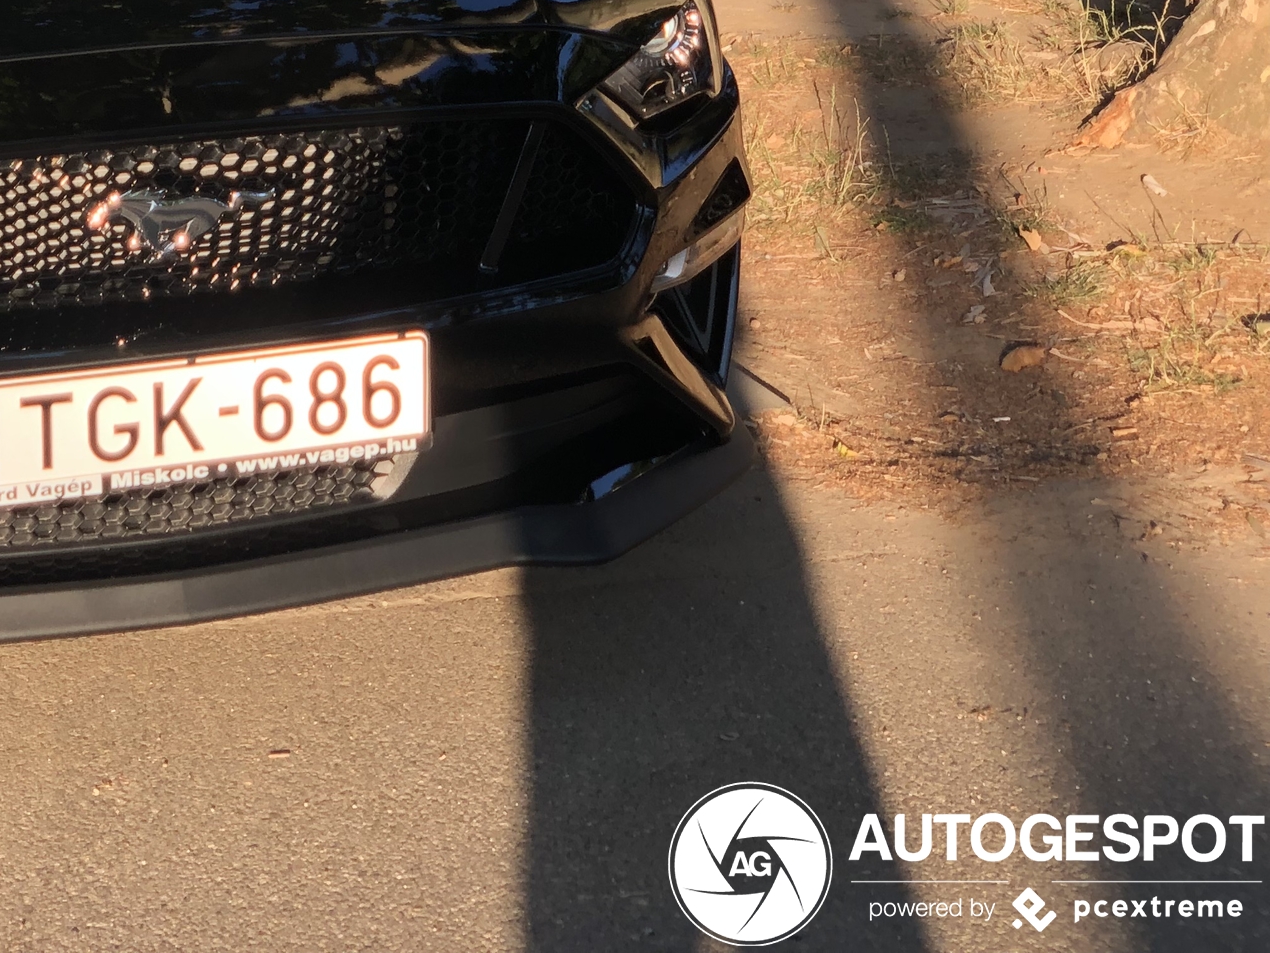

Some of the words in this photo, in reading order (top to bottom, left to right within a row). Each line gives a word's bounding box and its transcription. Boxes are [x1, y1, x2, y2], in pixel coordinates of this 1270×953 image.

[19, 354, 402, 470] TGK-686
[26, 478, 93, 498] Vagép
[110, 464, 210, 489] Miskolc
[235, 437, 417, 474] www.vagep.hu
